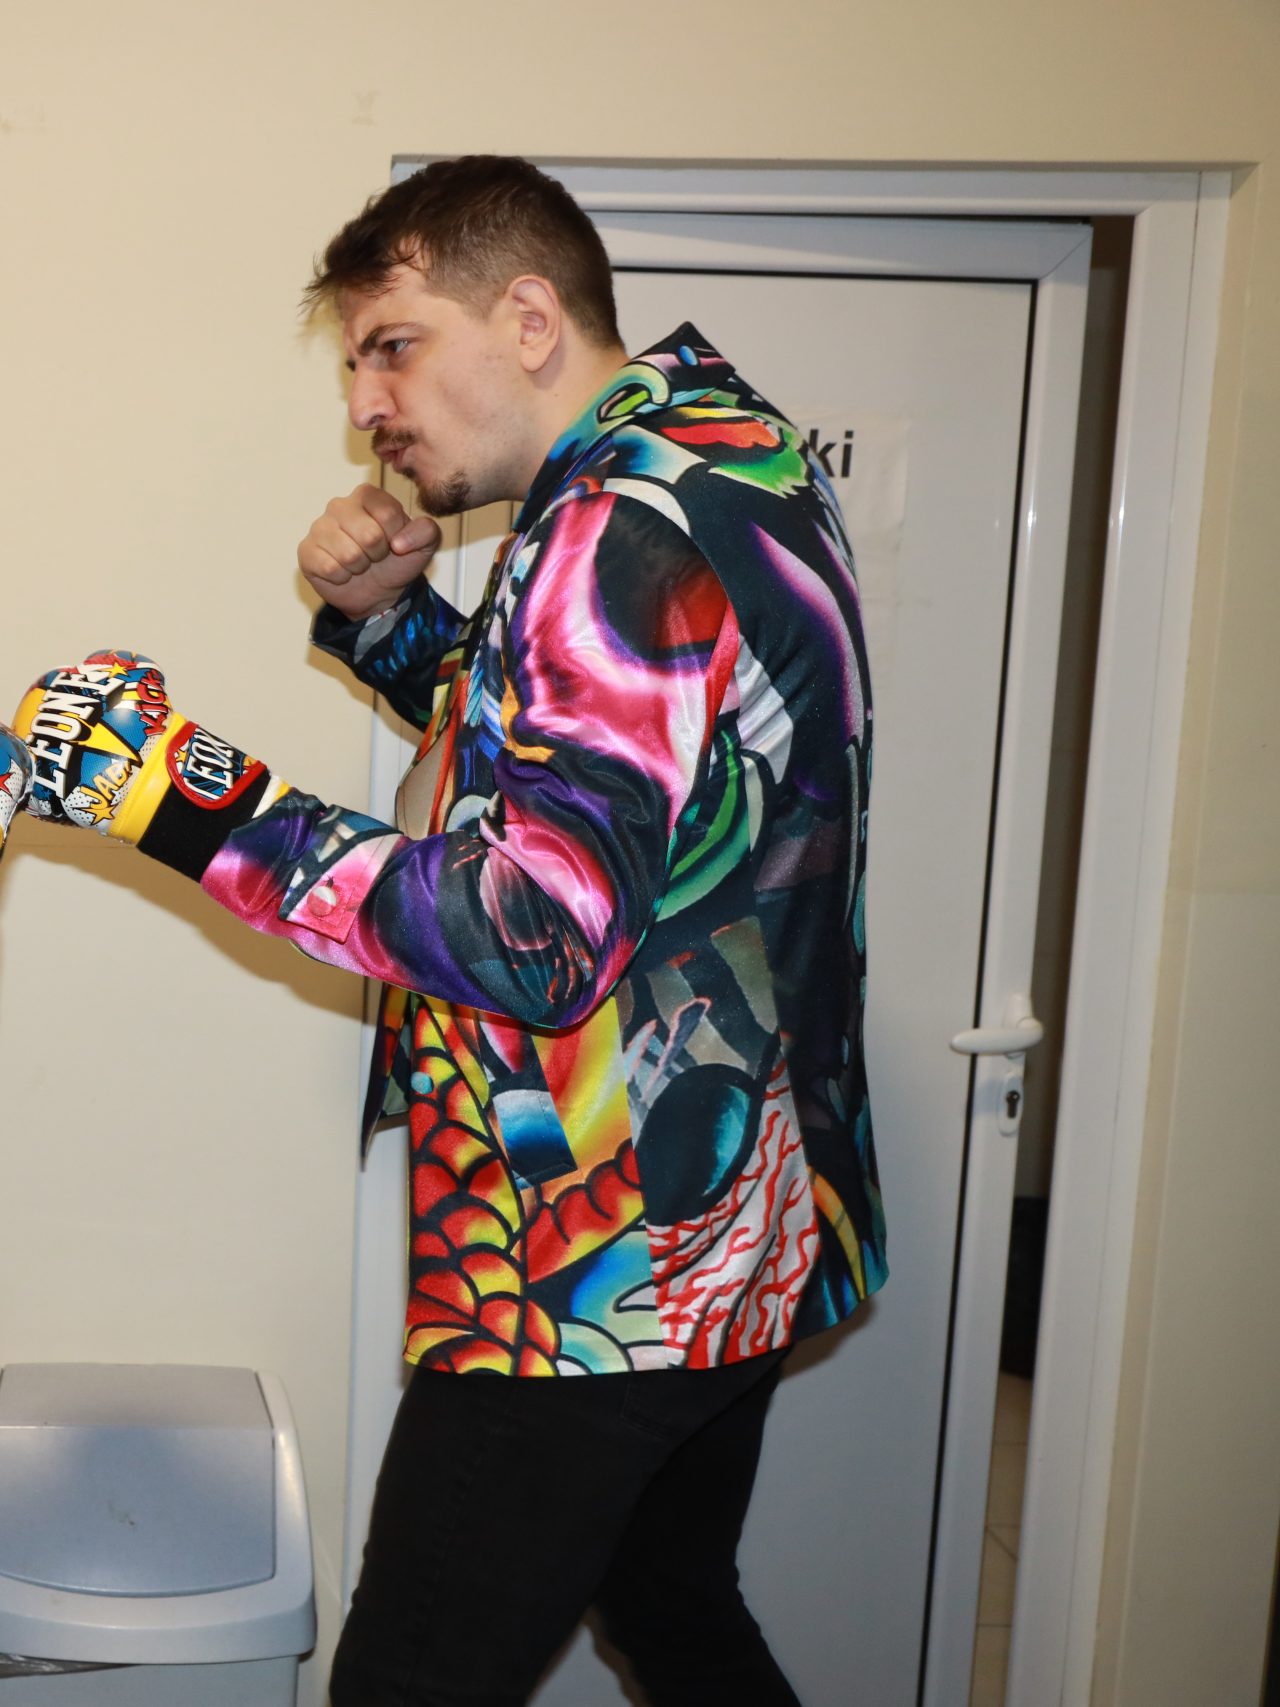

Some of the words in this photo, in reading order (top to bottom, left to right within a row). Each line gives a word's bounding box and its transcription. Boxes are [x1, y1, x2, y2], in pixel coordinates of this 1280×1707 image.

[808, 428, 854, 478] ki
[25, 670, 126, 800] LEONE
[182, 727, 235, 801] LEON
